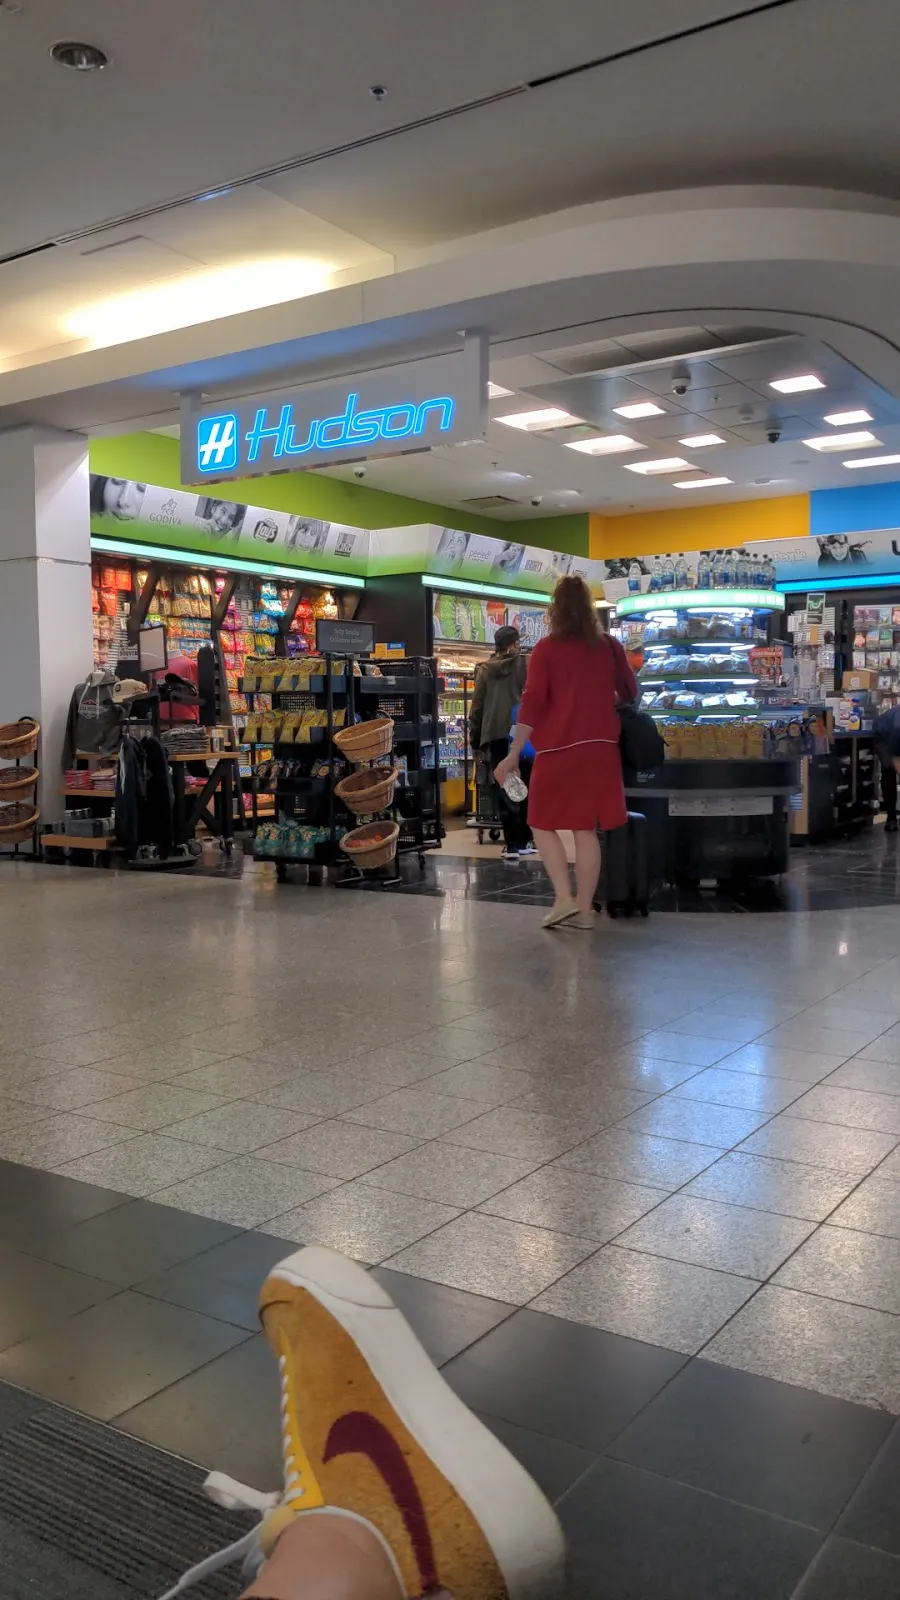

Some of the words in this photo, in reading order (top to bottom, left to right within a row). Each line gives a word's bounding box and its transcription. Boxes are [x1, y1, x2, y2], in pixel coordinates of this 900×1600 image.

[244, 393, 454, 460] Hudson
[149, 512, 182, 527] GODIVA
[773, 549, 808, 565] People
